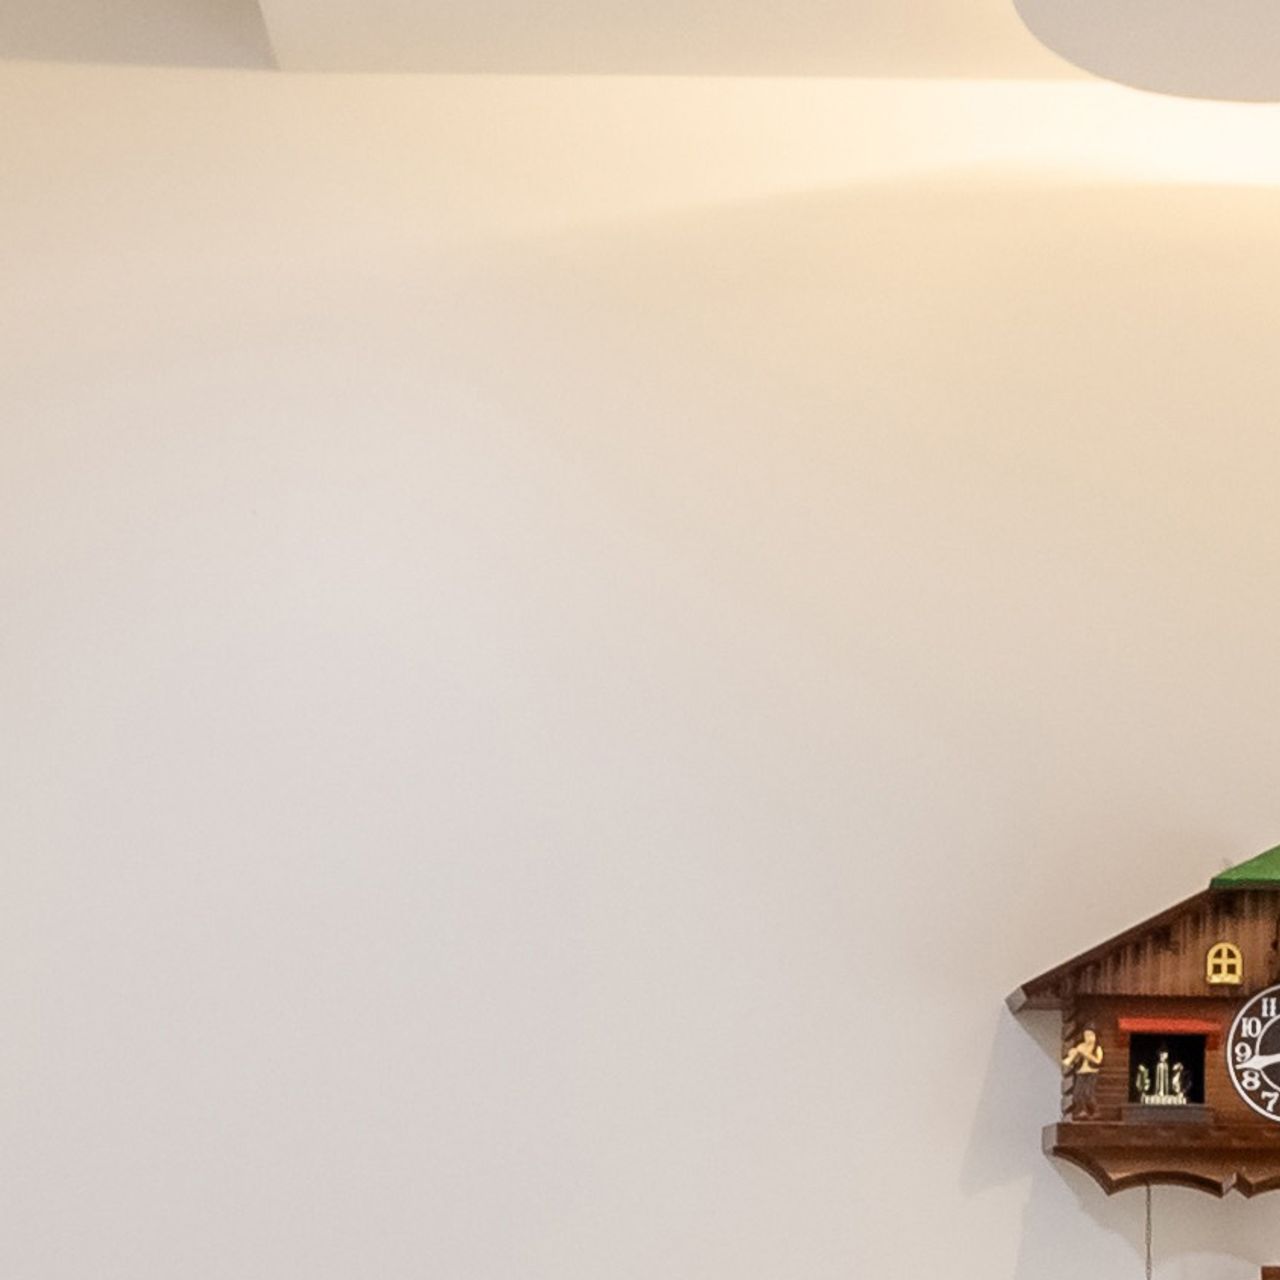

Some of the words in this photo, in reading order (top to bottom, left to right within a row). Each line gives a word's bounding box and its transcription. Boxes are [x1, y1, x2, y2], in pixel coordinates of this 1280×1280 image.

[1261, 997, 1277, 1018] 11
[1241, 1017, 1262, 1038] 10
[1234, 1042, 1252, 1063] 9
[1241, 1070, 1261, 1091] 8
[1260, 1091, 1280, 1112] 7
